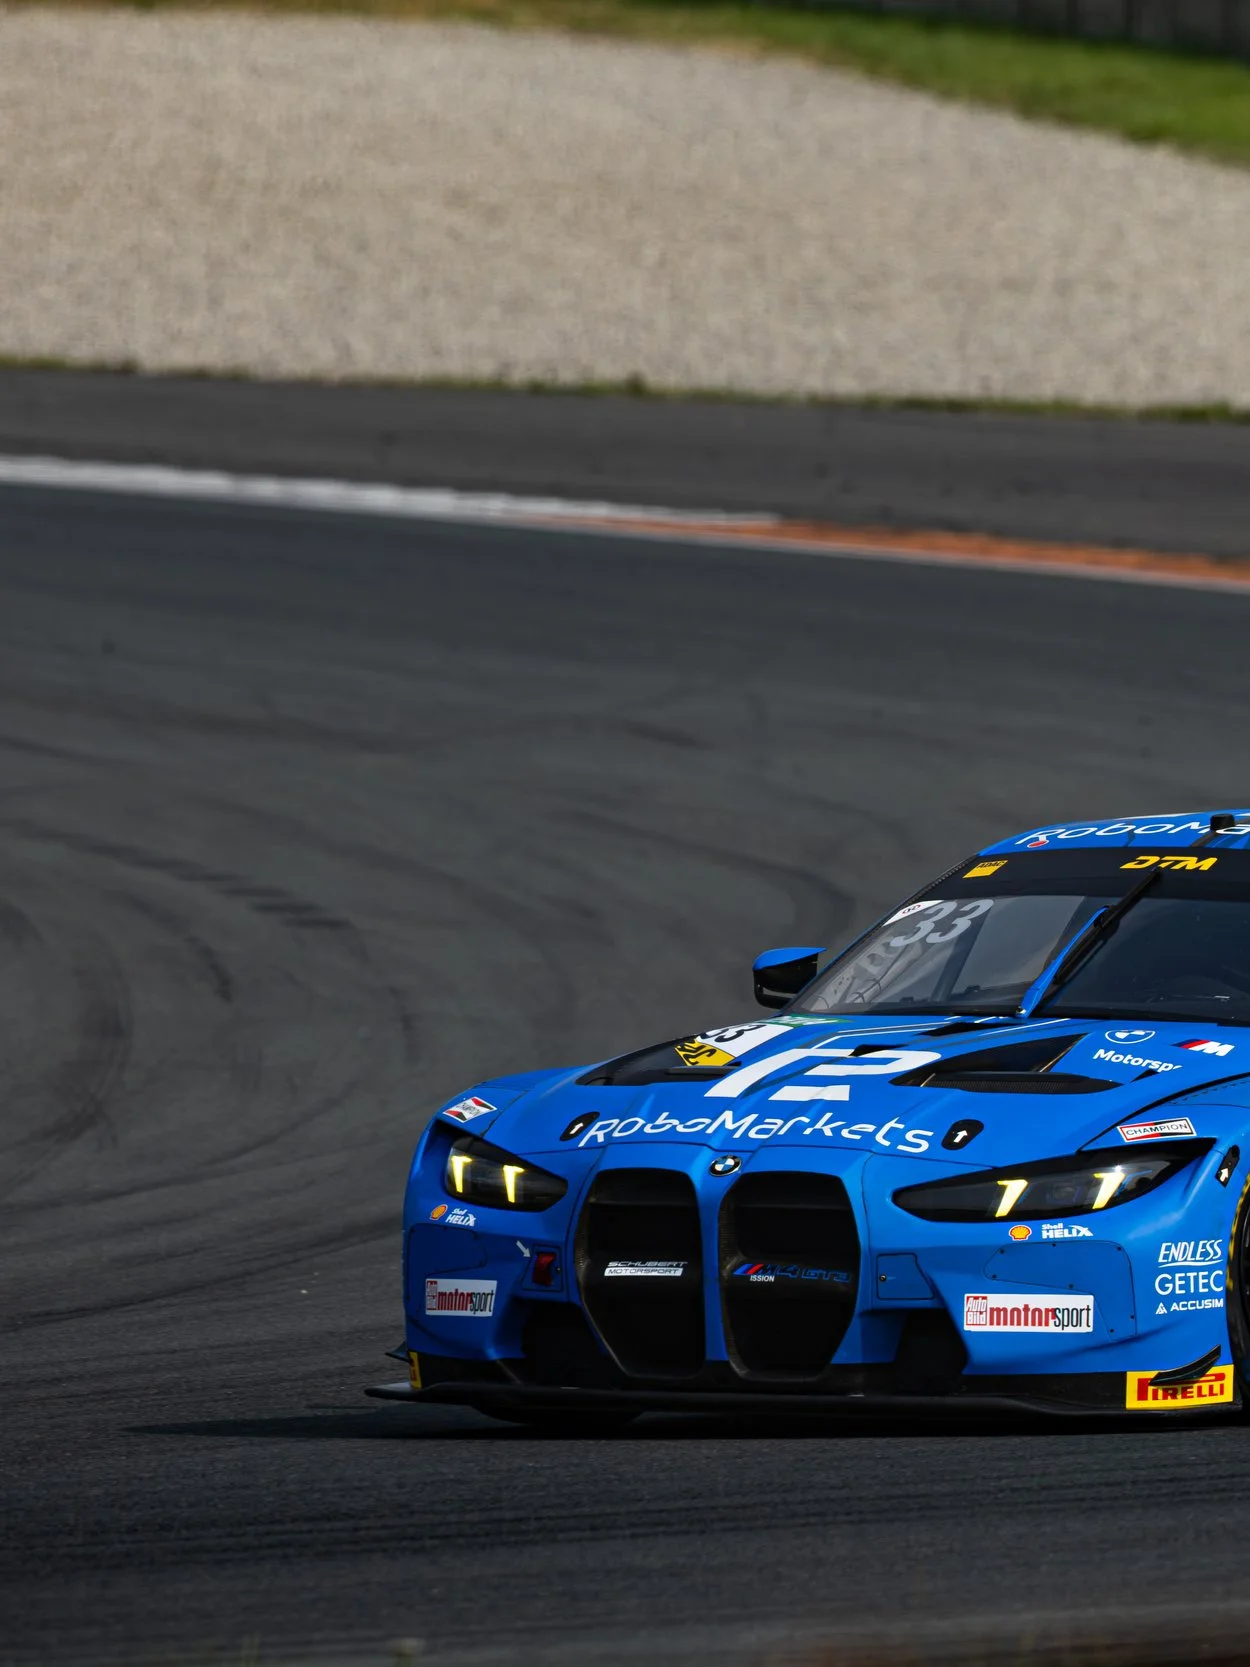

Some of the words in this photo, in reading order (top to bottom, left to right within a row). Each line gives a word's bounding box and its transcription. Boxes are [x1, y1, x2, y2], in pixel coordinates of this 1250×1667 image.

[1120, 855, 1218, 871] DTM
[889, 899, 994, 947] 33
[577, 1110, 935, 1154] RoboMarkets
[1126, 1123, 1188, 1136] CHAMPION
[445, 1213, 477, 1227] HELIX
[1042, 1224, 1093, 1239] HELIX
[1158, 1239, 1223, 1265] ENDLESS
[1155, 1270, 1224, 1296] GETEC
[437, 1288, 495, 1315] motorsport
[966, 1297, 987, 1311] Auto
[1170, 1298, 1224, 1312] ACCUSIM
[966, 1311, 987, 1325] Bild
[989, 1304, 1092, 1331] motorsport
